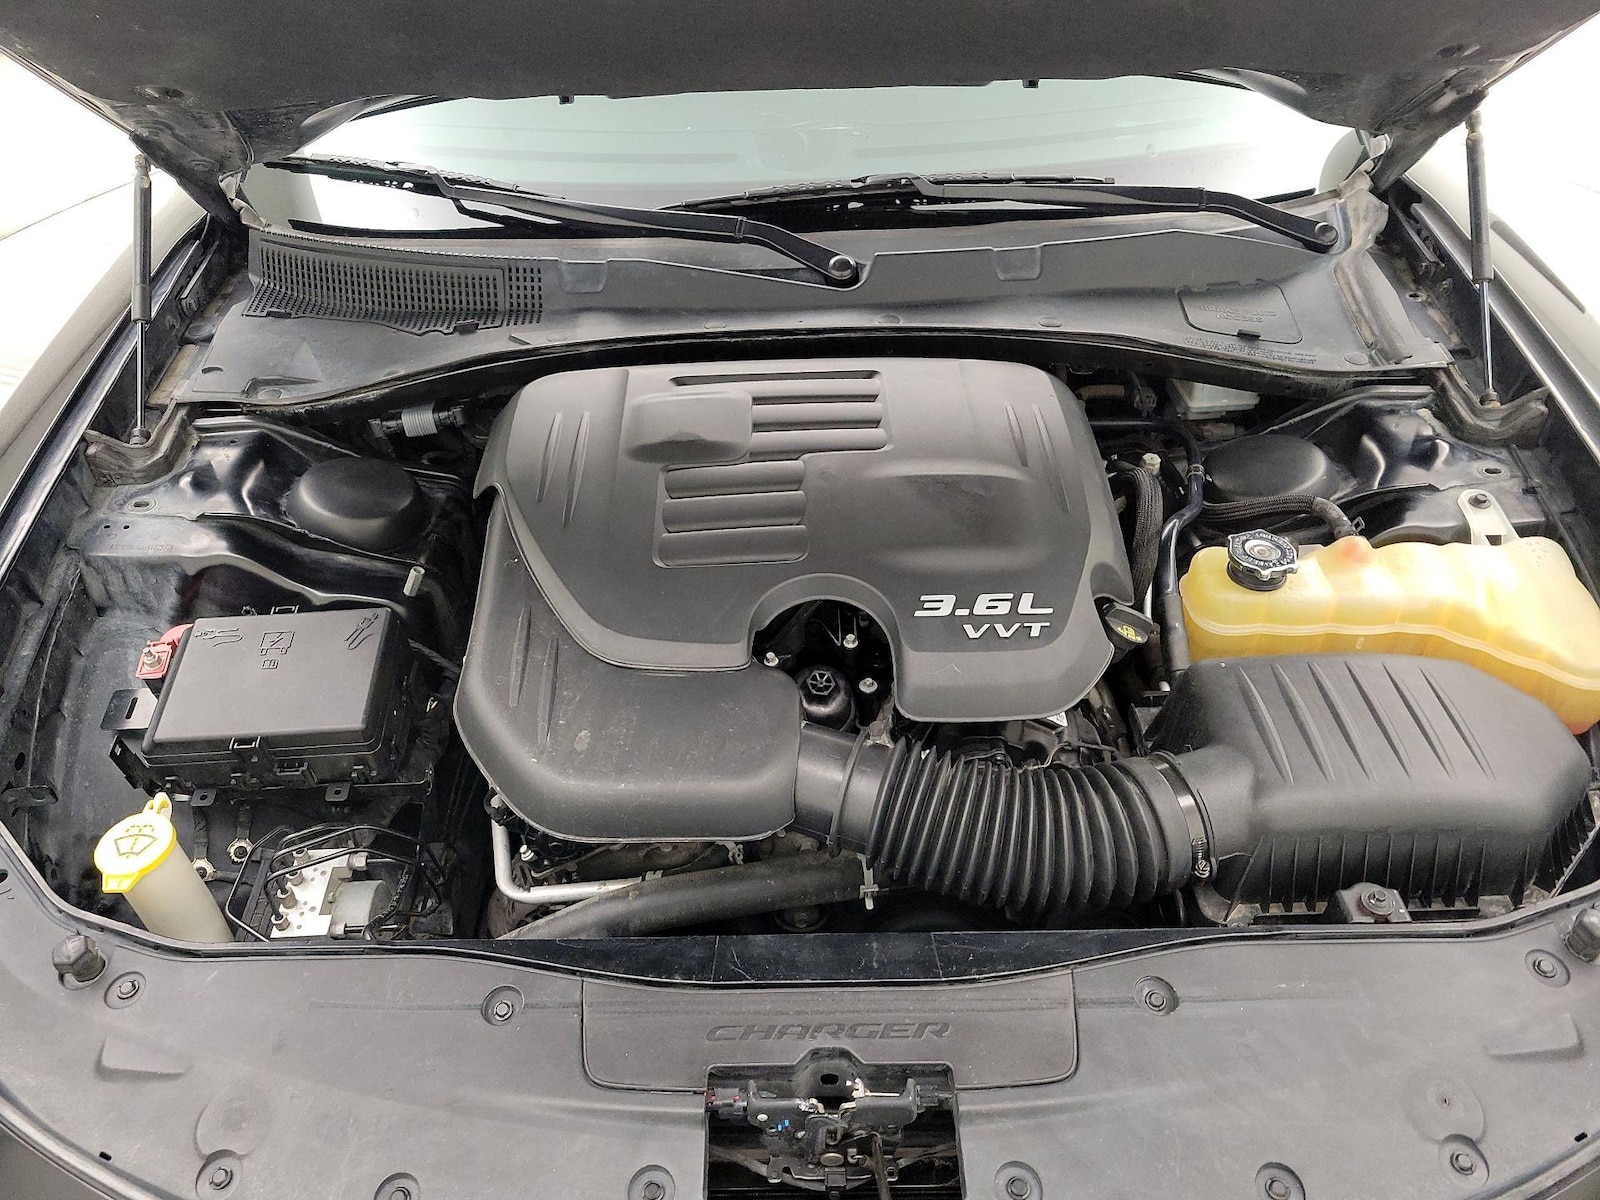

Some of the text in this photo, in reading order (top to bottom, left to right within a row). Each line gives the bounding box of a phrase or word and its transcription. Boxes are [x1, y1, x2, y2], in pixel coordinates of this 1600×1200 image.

[913, 592, 1054, 617] 3.6L
[962, 622, 1050, 639] VVT
[704, 1022, 950, 1042] CHARGER
